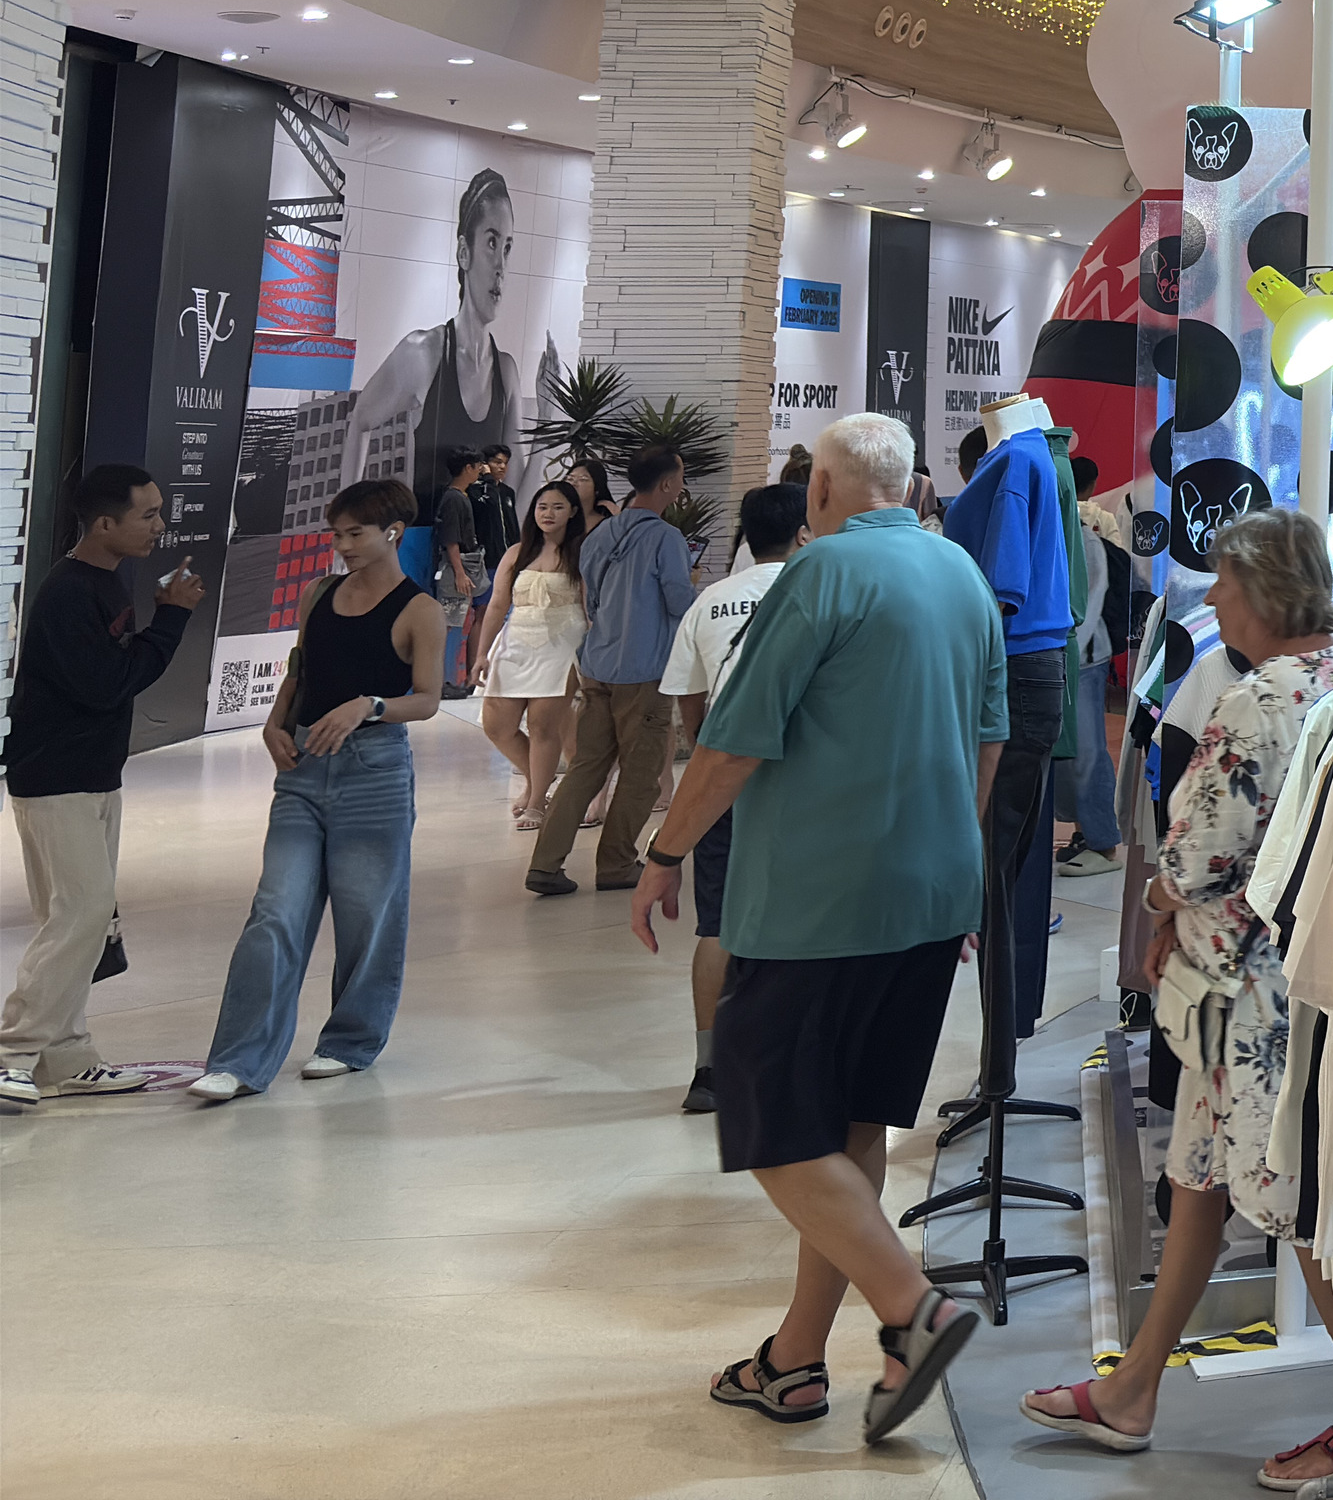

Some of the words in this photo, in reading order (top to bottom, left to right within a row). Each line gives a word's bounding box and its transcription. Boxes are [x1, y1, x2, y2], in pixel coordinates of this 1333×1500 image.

[800, 287, 830, 307] OPENING
[784, 306, 819, 326] FEBRUARY
[820, 310, 839, 326] 2025
[947, 295, 980, 336] NIKE
[946, 336, 1001, 377] PATTAYA
[175, 385, 223, 409] VALIRAM
[777, 383, 801, 408] FOR
[802, 384, 838, 409] SPORT
[945, 389, 978, 412] HELPING
[182, 432, 195, 444] STEP
[195, 433, 208, 444] INTO
[194, 464, 203, 475] US
[257, 662, 272, 678] AM
[251, 684, 265, 695] SCAN
[265, 683, 274, 693] ME
[250, 697, 259, 706] SEE
[260, 695, 276, 706] WHAT
